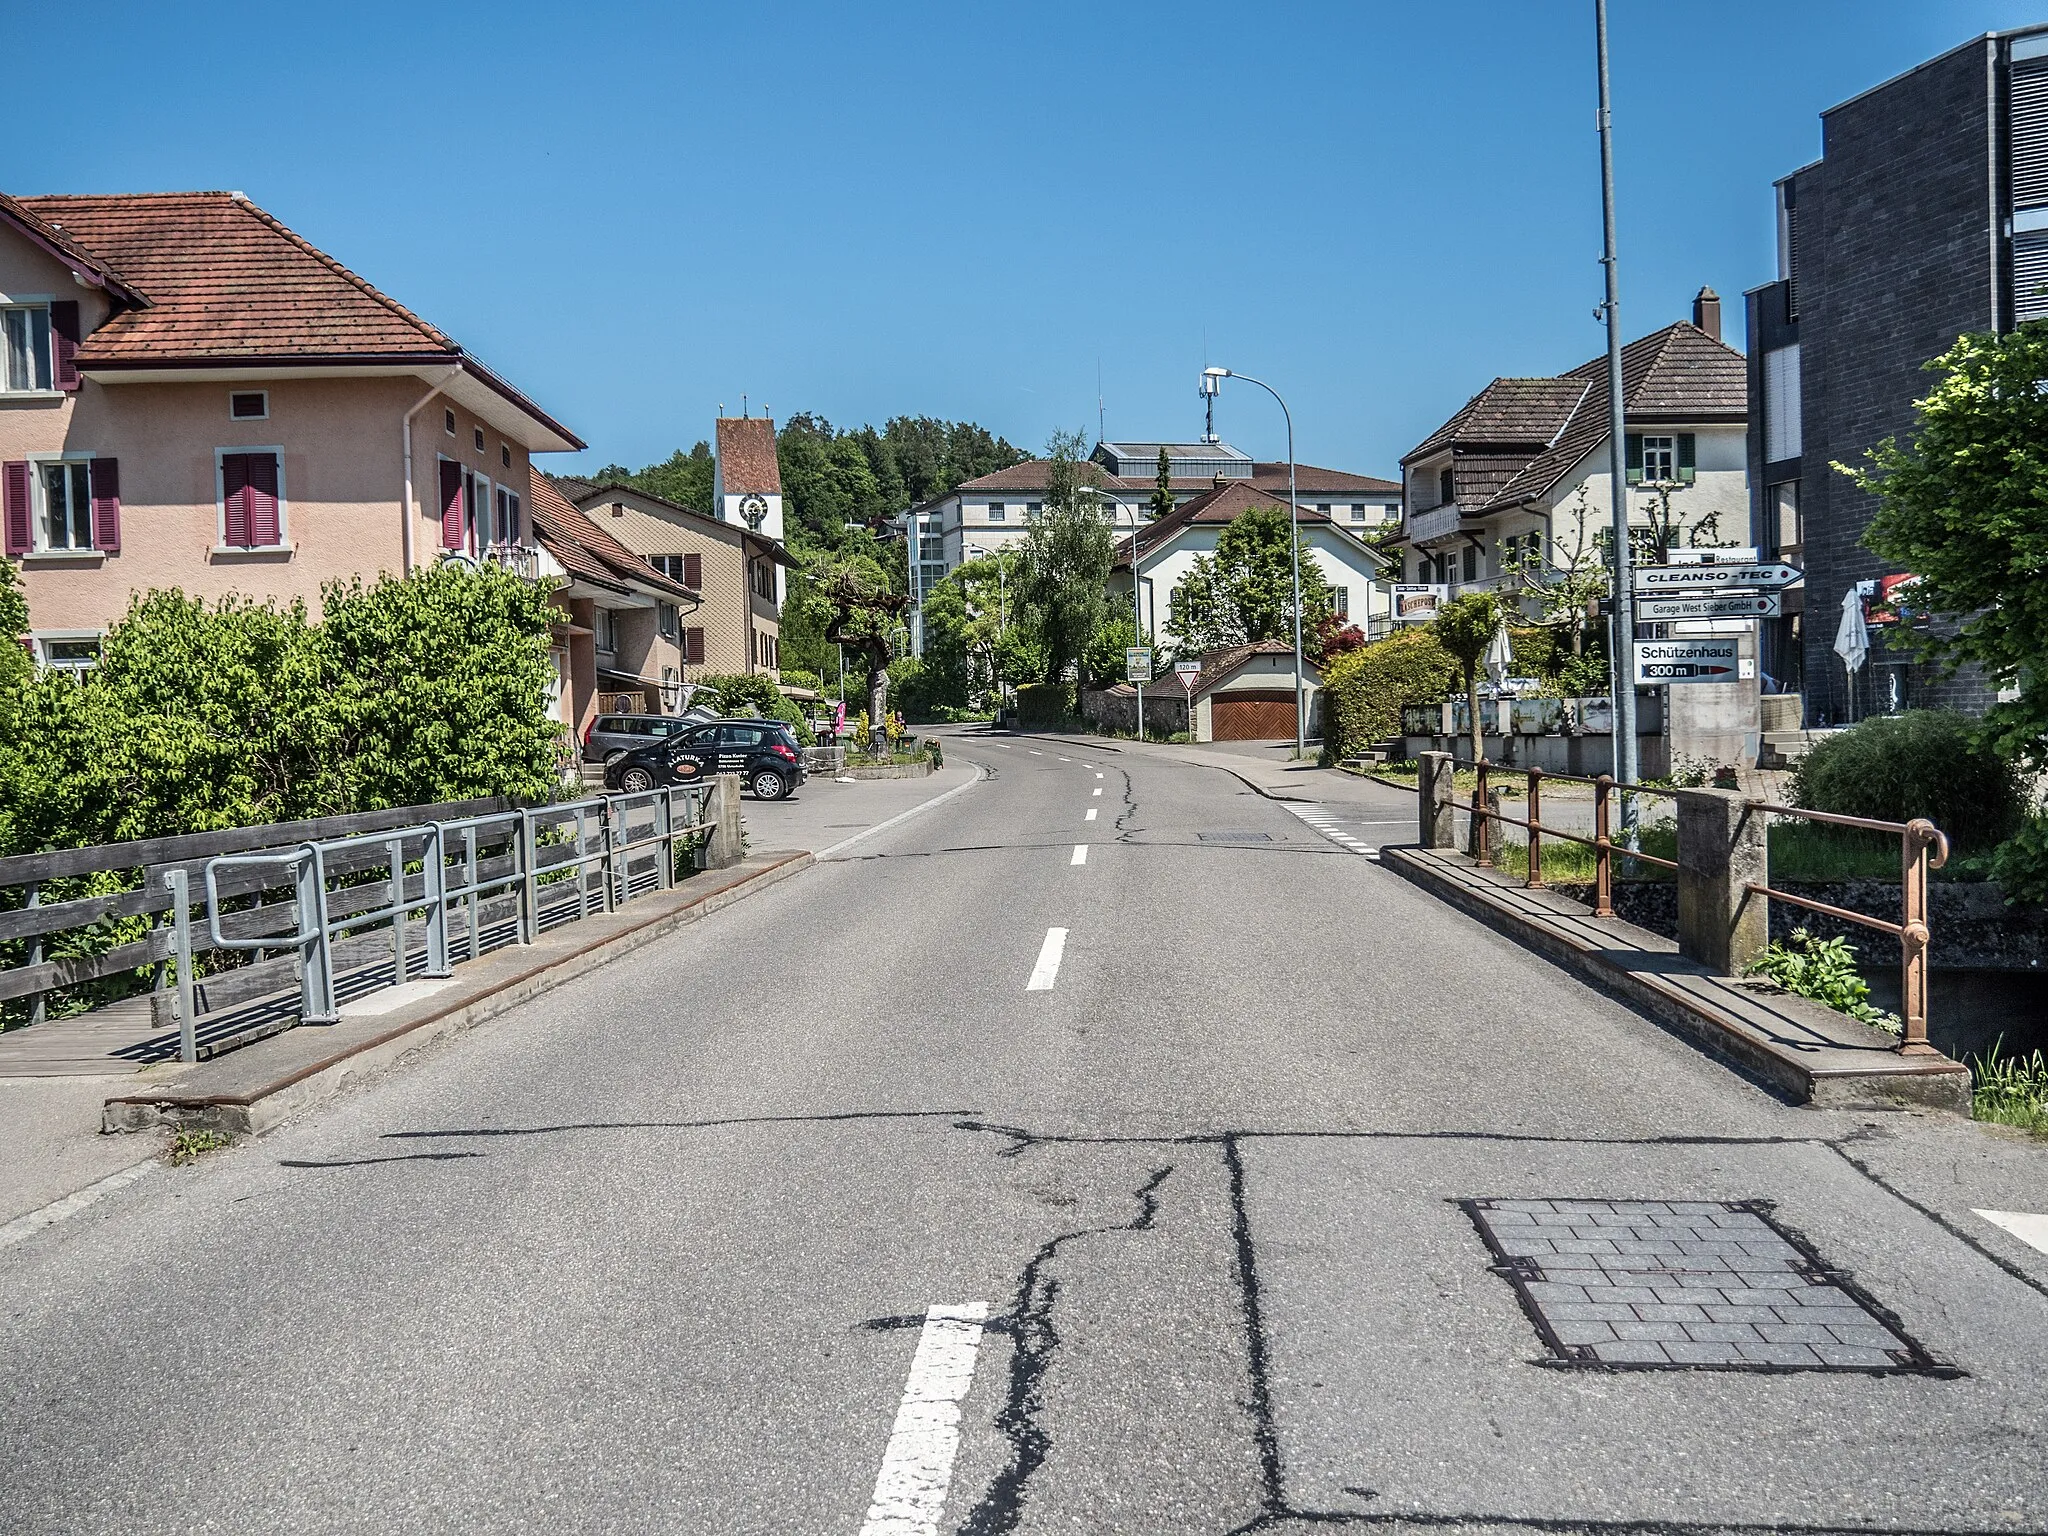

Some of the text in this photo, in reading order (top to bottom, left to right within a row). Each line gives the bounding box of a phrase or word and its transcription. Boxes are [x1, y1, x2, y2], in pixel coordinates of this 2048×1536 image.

[1647, 572, 1728, 582] CLEANSO
[1653, 602, 1752, 615] Garage West Sieber GmbH
[1641, 646, 1733, 658] Schützenhaus
[1649, 665, 1687, 676] 300 m
[668, 754, 704, 768] ALATURKA
